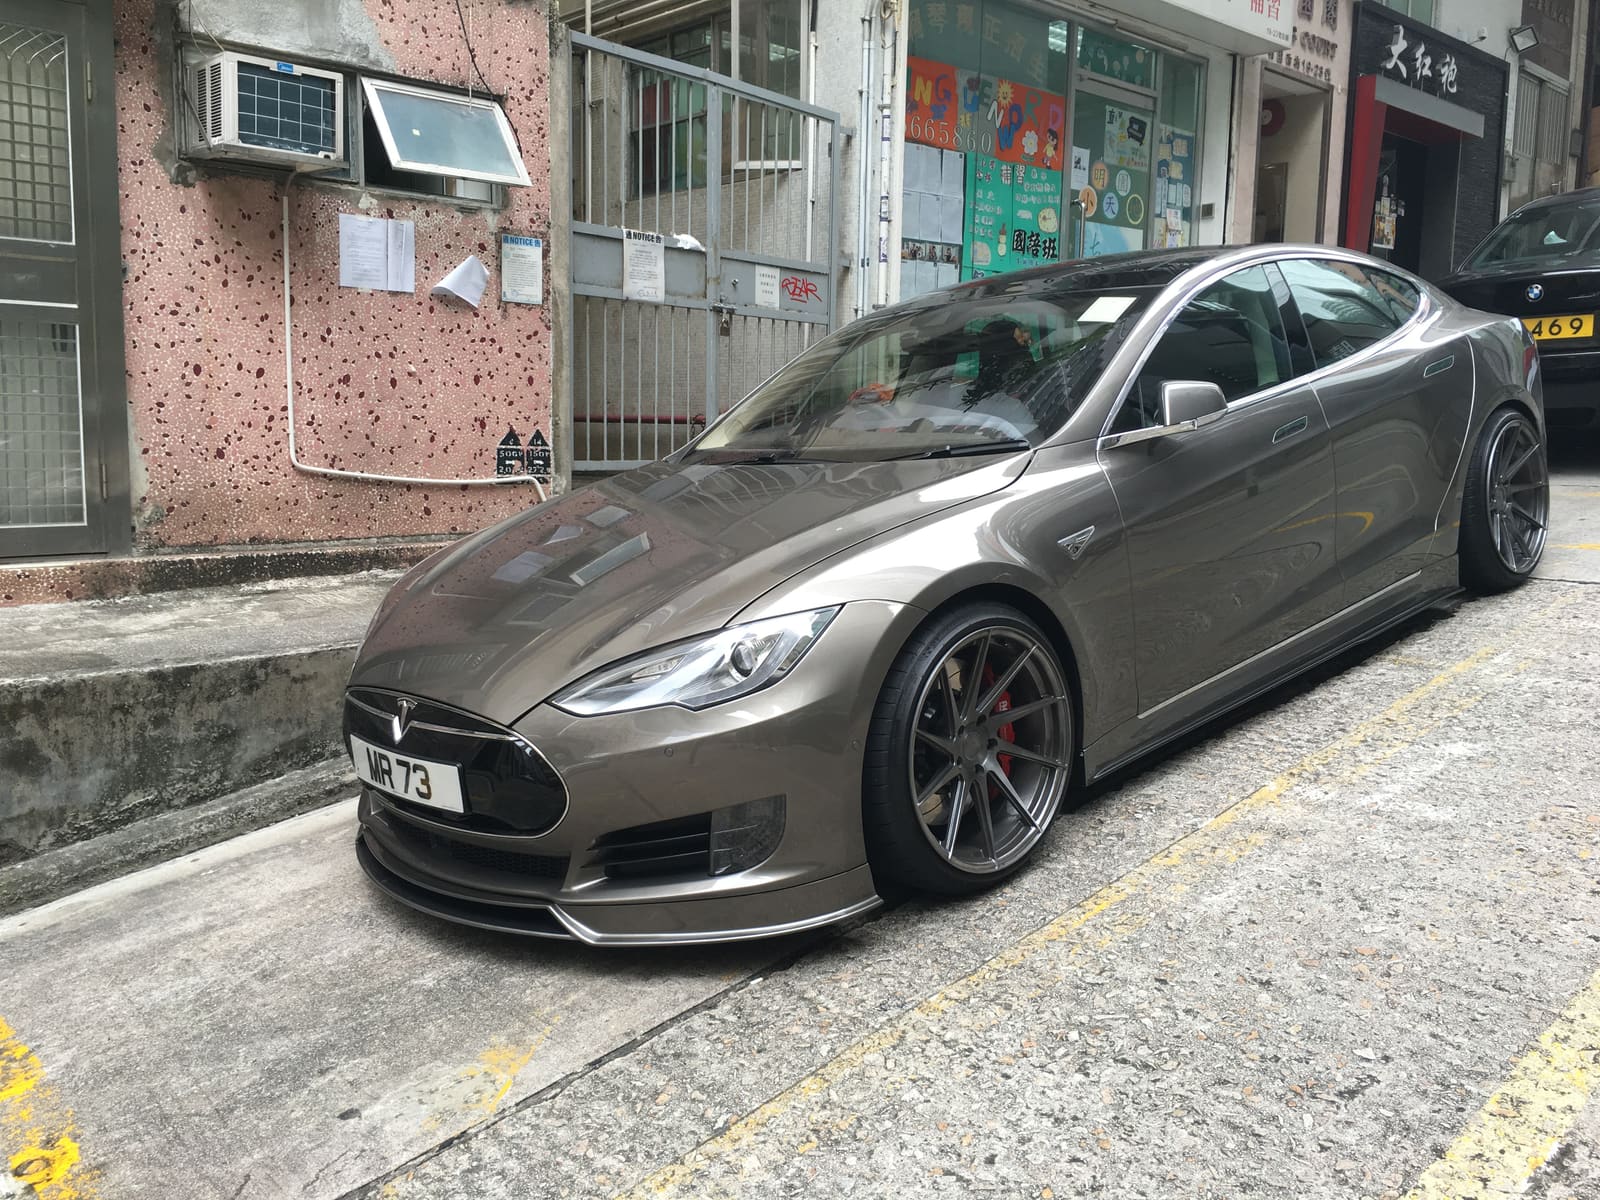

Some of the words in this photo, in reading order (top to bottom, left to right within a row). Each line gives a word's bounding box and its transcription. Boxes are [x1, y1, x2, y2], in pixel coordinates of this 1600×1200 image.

[904, 115, 992, 154] 665860
[510, 236, 534, 247] NOTICE
[633, 231, 655, 242] NOTICE
[1531, 317, 1584, 337] 469
[366, 746, 395, 789] MR
[396, 759, 432, 801] 73
